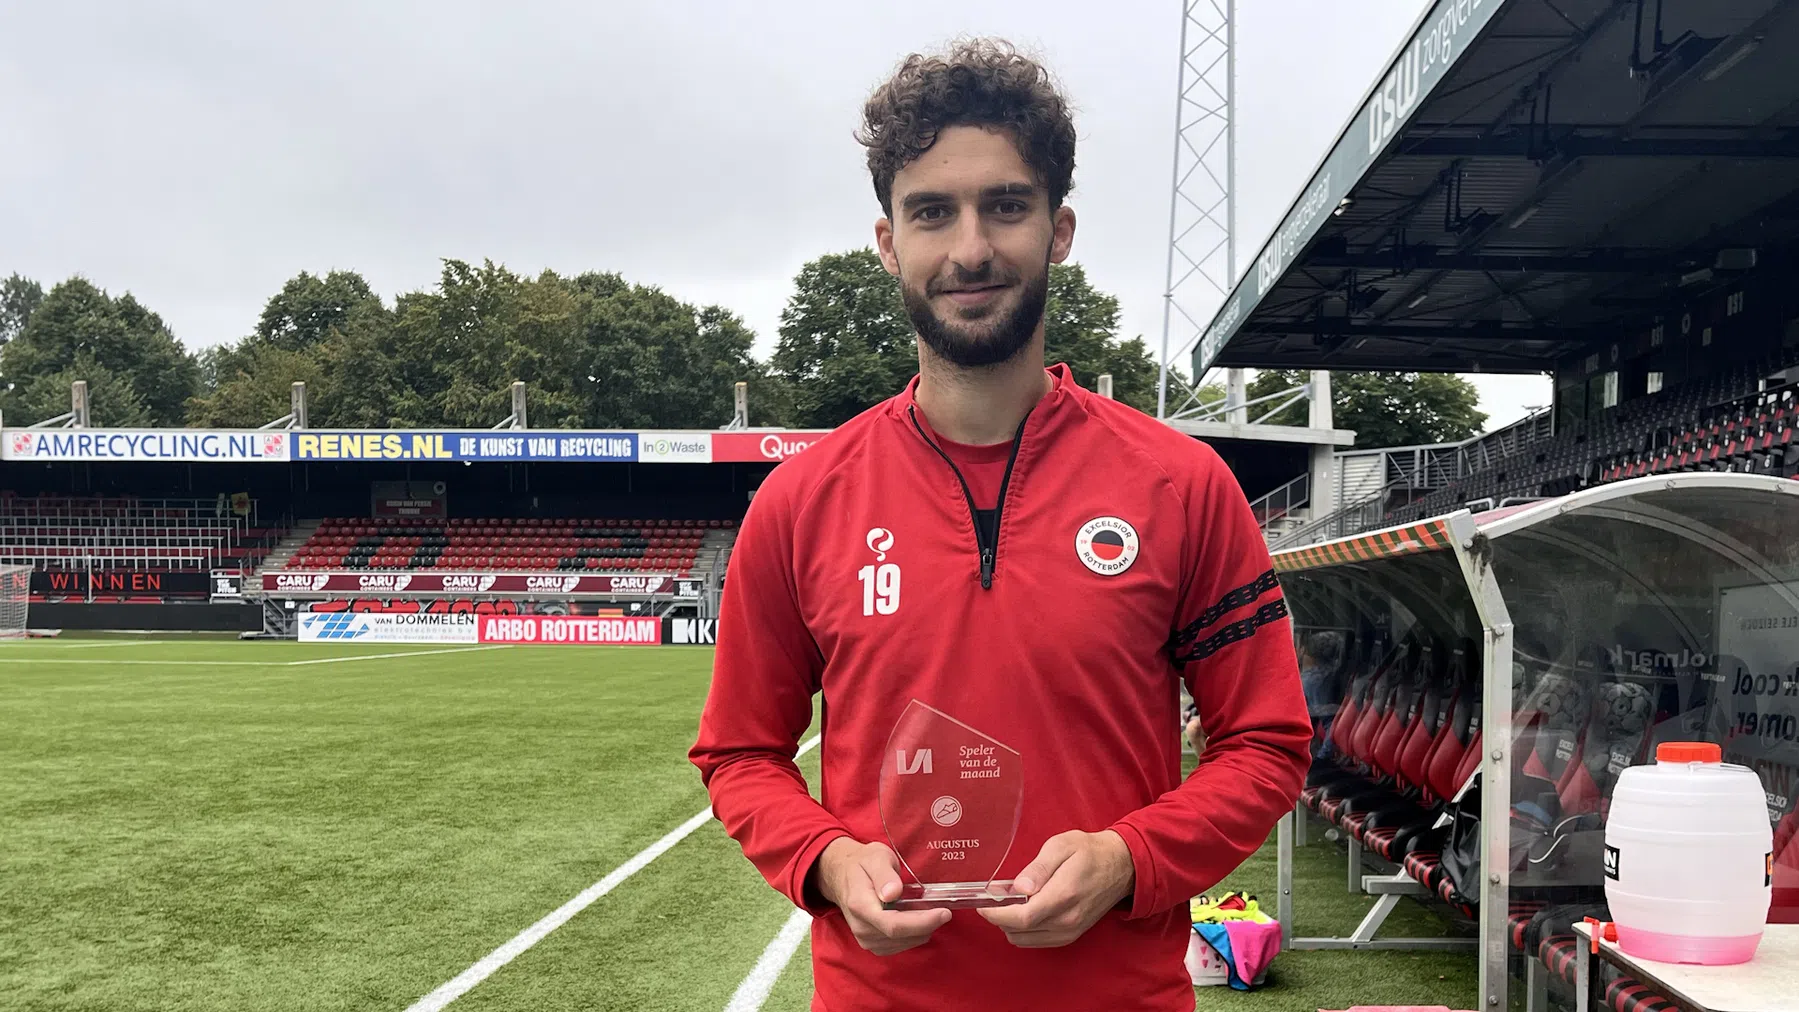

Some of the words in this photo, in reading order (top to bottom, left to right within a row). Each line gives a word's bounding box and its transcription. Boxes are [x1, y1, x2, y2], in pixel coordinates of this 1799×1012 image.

[1369, 39, 1420, 155] DSW
[1257, 232, 1282, 296] DSW
[35, 434, 262, 458] AMRECYCLING.NL
[298, 434, 452, 459] RENES.NL
[460, 437, 476, 456] DE
[480, 437, 524, 456] KUNST
[528, 438, 556, 457] VAN
[560, 437, 632, 457] RECYCLING
[760, 434, 816, 460] Quo
[1085, 520, 1132, 539] EXCELSIOR
[1083, 551, 1129, 571] ROTTERDAM
[276, 575, 312, 586] CARU
[359, 575, 394, 586] CARU
[442, 575, 478, 587] CARU
[526, 577, 562, 588] CARU
[610, 577, 646, 588] CARU
[858, 563, 901, 616] 19
[396, 614, 475, 625] DOMMELEN
[485, 619, 536, 641] ARBO
[541, 619, 655, 643] ROTTERDAM
[959, 744, 995, 759] Speler
[960, 759, 981, 768] van
[983, 756, 997, 768] de
[960, 767, 1000, 779] maand
[926, 839, 980, 850] AUGUSTUS
[941, 851, 966, 861] 2023
